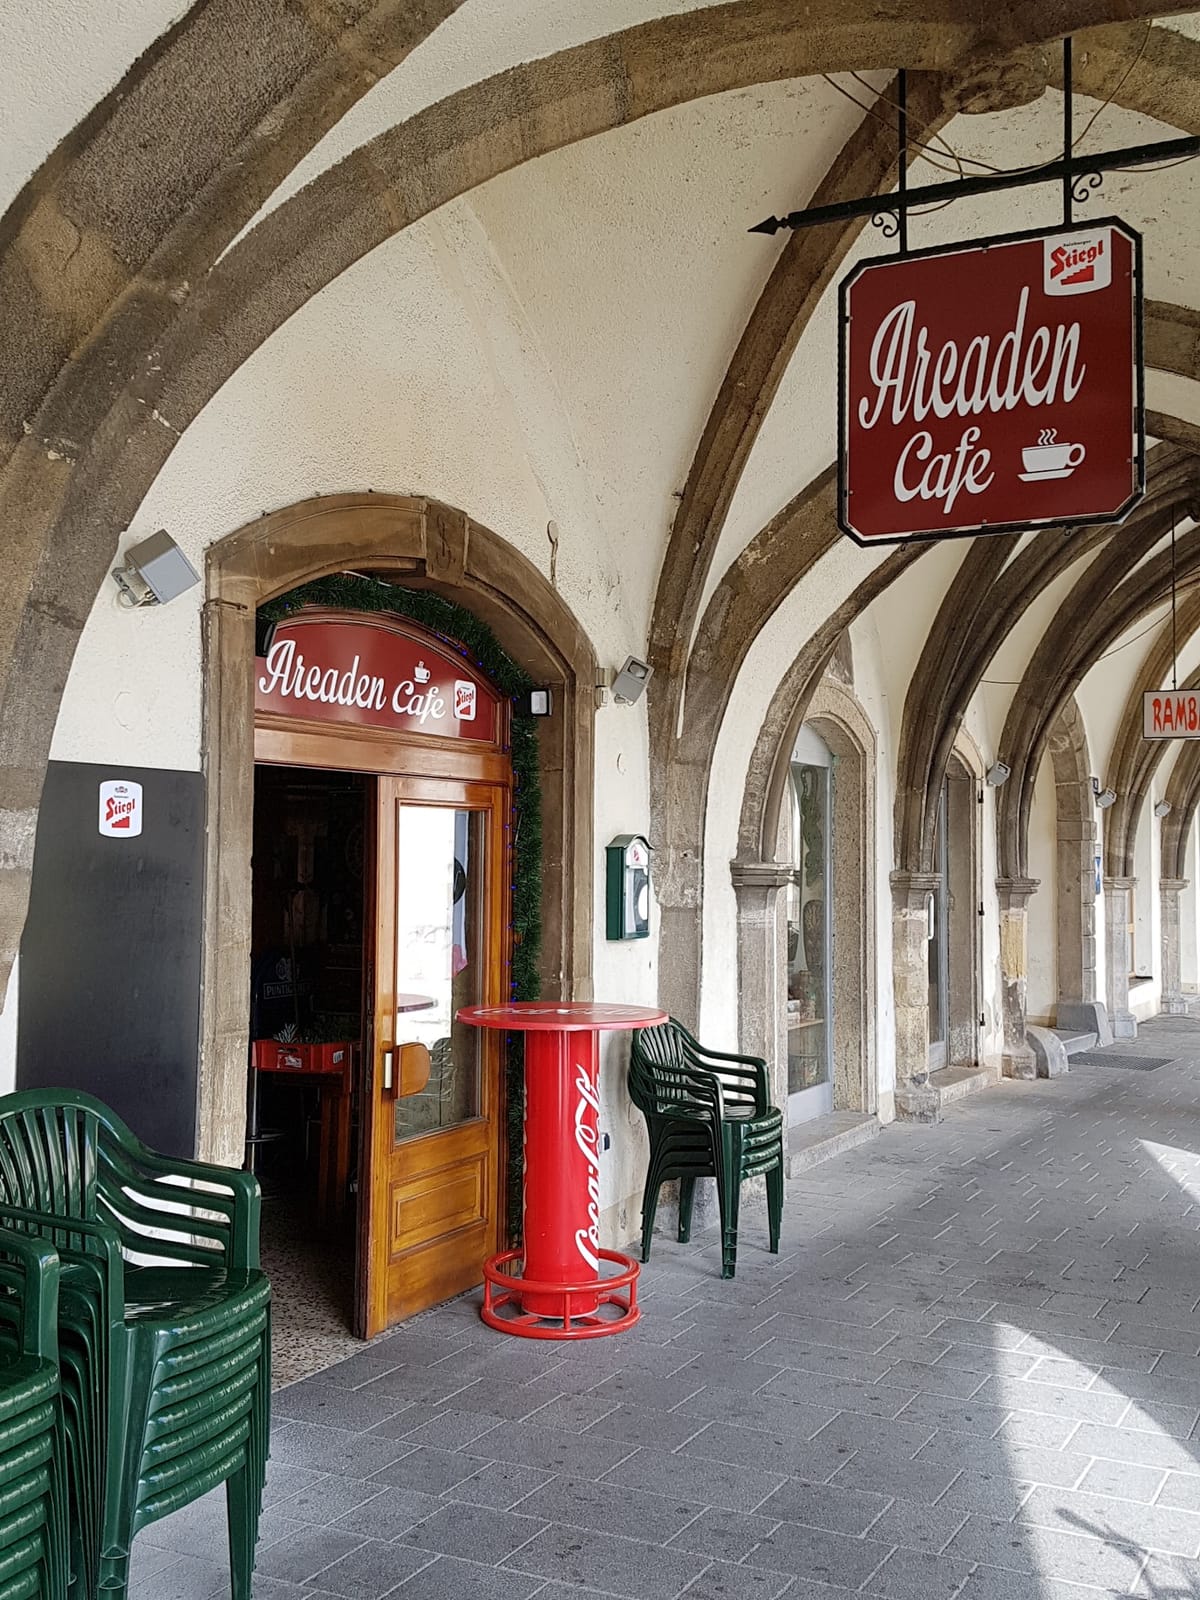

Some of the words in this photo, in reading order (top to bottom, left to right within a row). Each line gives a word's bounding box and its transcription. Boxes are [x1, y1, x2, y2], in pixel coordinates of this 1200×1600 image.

[1050, 240, 1104, 280] Stiegl
[858, 285, 1086, 429] Arcaden
[894, 426, 995, 514] Cafe
[258, 639, 387, 711] Arcaden
[391, 680, 447, 724] Cafe
[1152, 696, 1200, 733] RAMB
[105, 797, 136, 821] Stiegl
